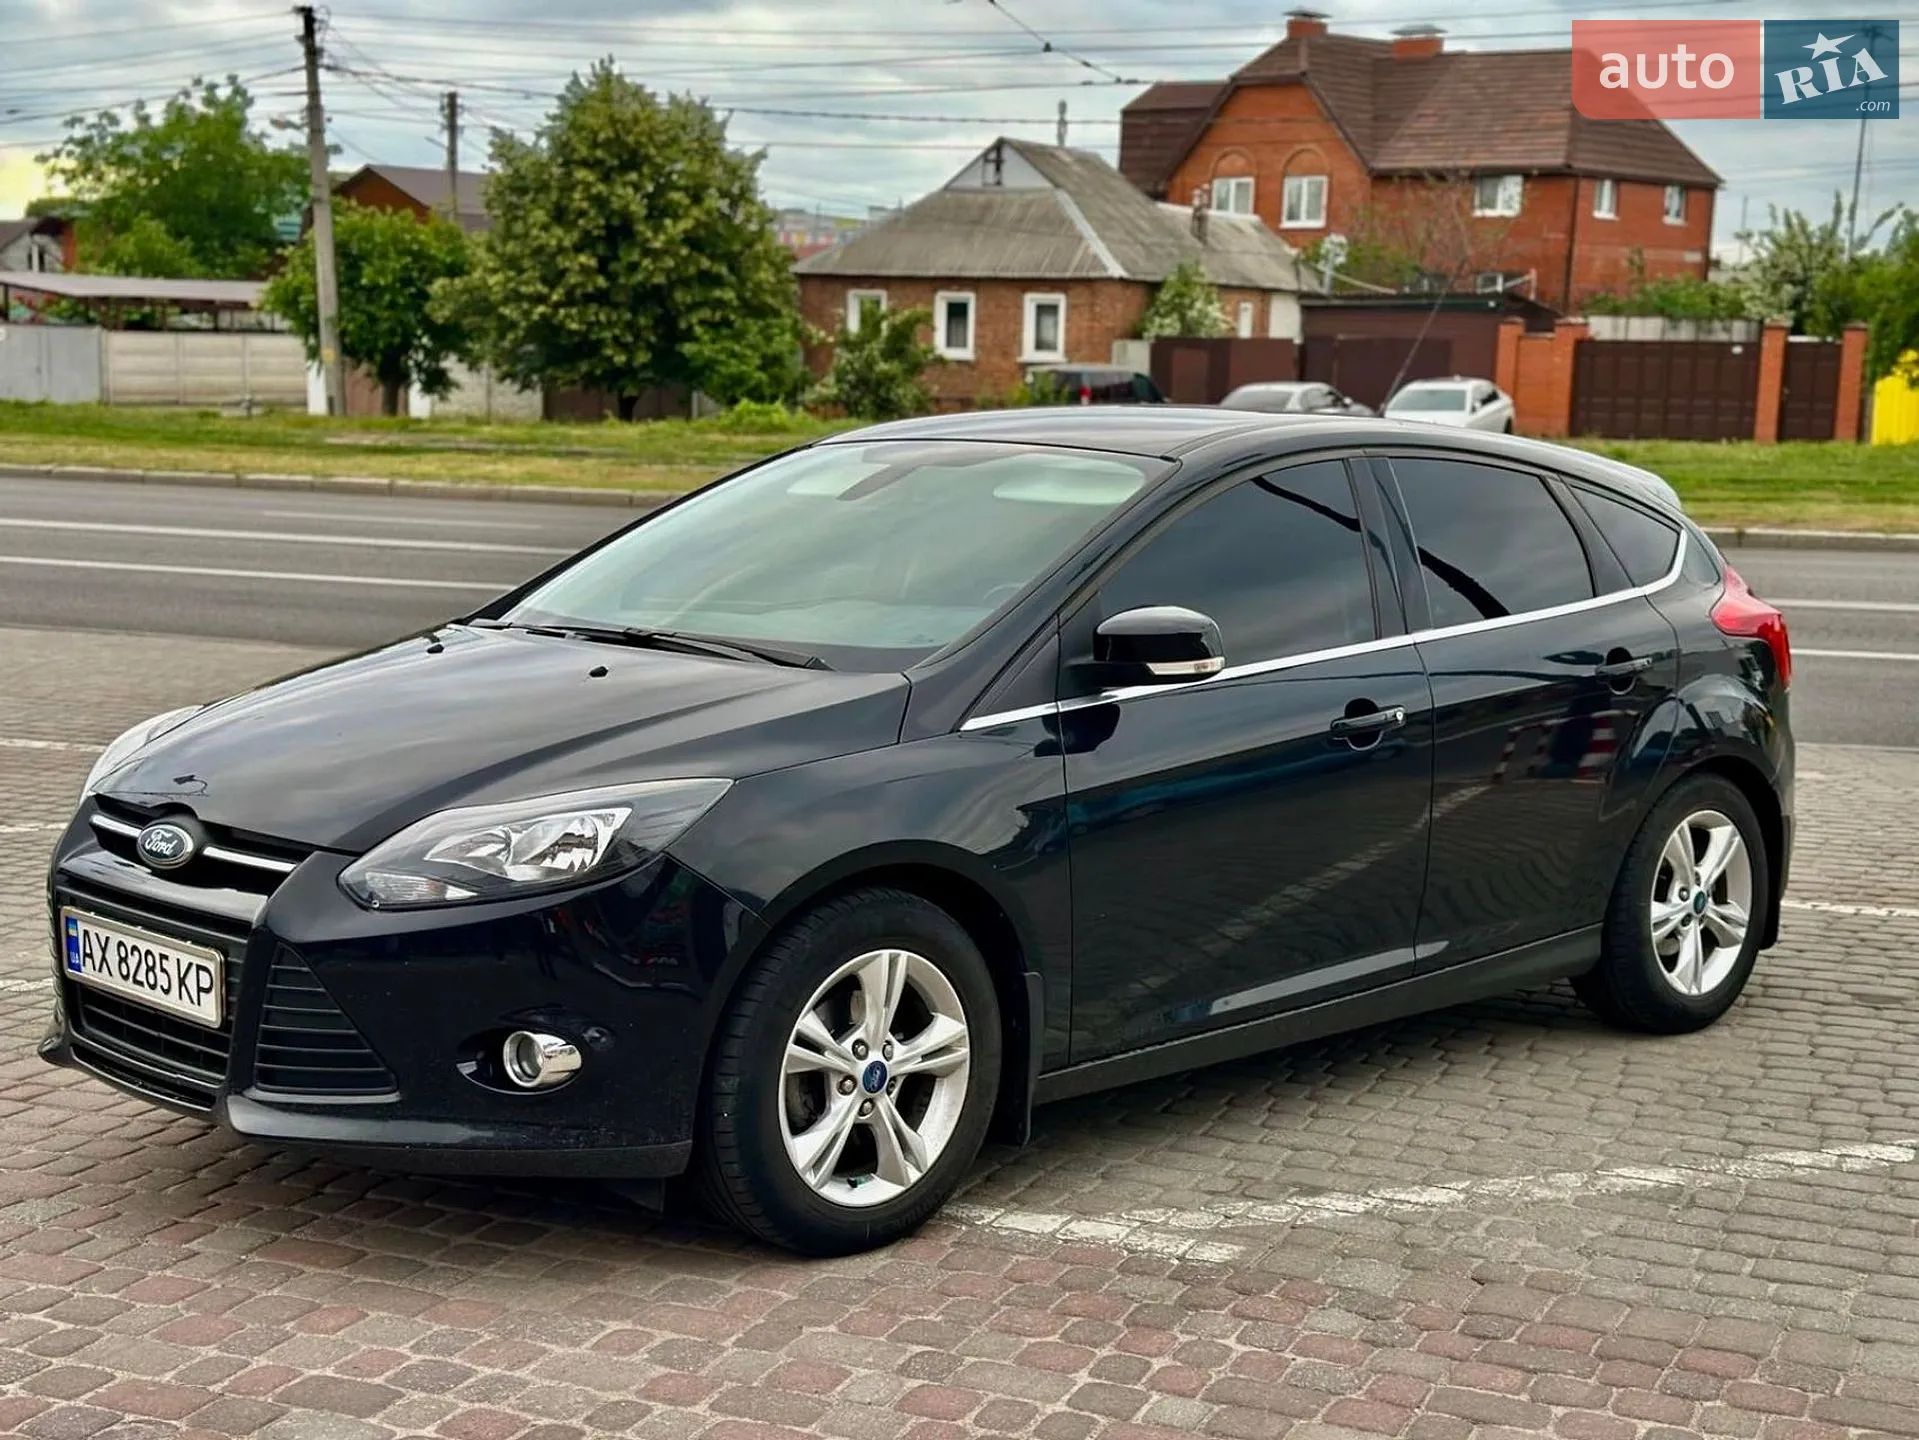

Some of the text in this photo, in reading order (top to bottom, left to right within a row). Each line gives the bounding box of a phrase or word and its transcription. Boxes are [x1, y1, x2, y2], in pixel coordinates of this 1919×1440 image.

[145, 829, 177, 855] Ford
[82, 928, 214, 1006] AX 8285 KP
